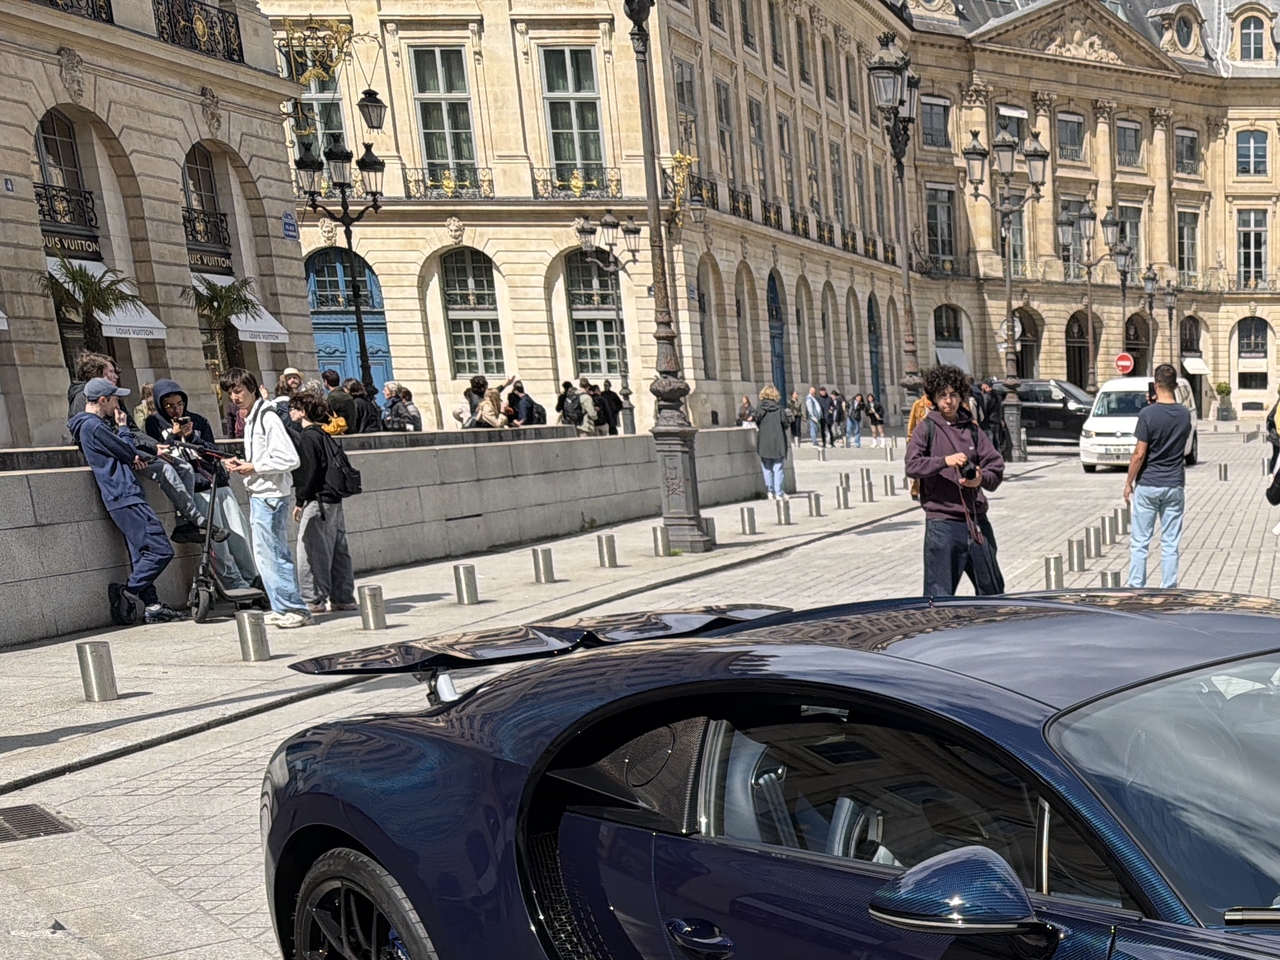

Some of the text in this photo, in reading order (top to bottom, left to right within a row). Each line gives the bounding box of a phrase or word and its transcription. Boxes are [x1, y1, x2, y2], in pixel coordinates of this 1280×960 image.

[42, 236, 100, 252] OUIS VUITTON
[203, 256, 232, 267] VUITTON
[115, 327, 155, 337] LOUIS VUITTON
